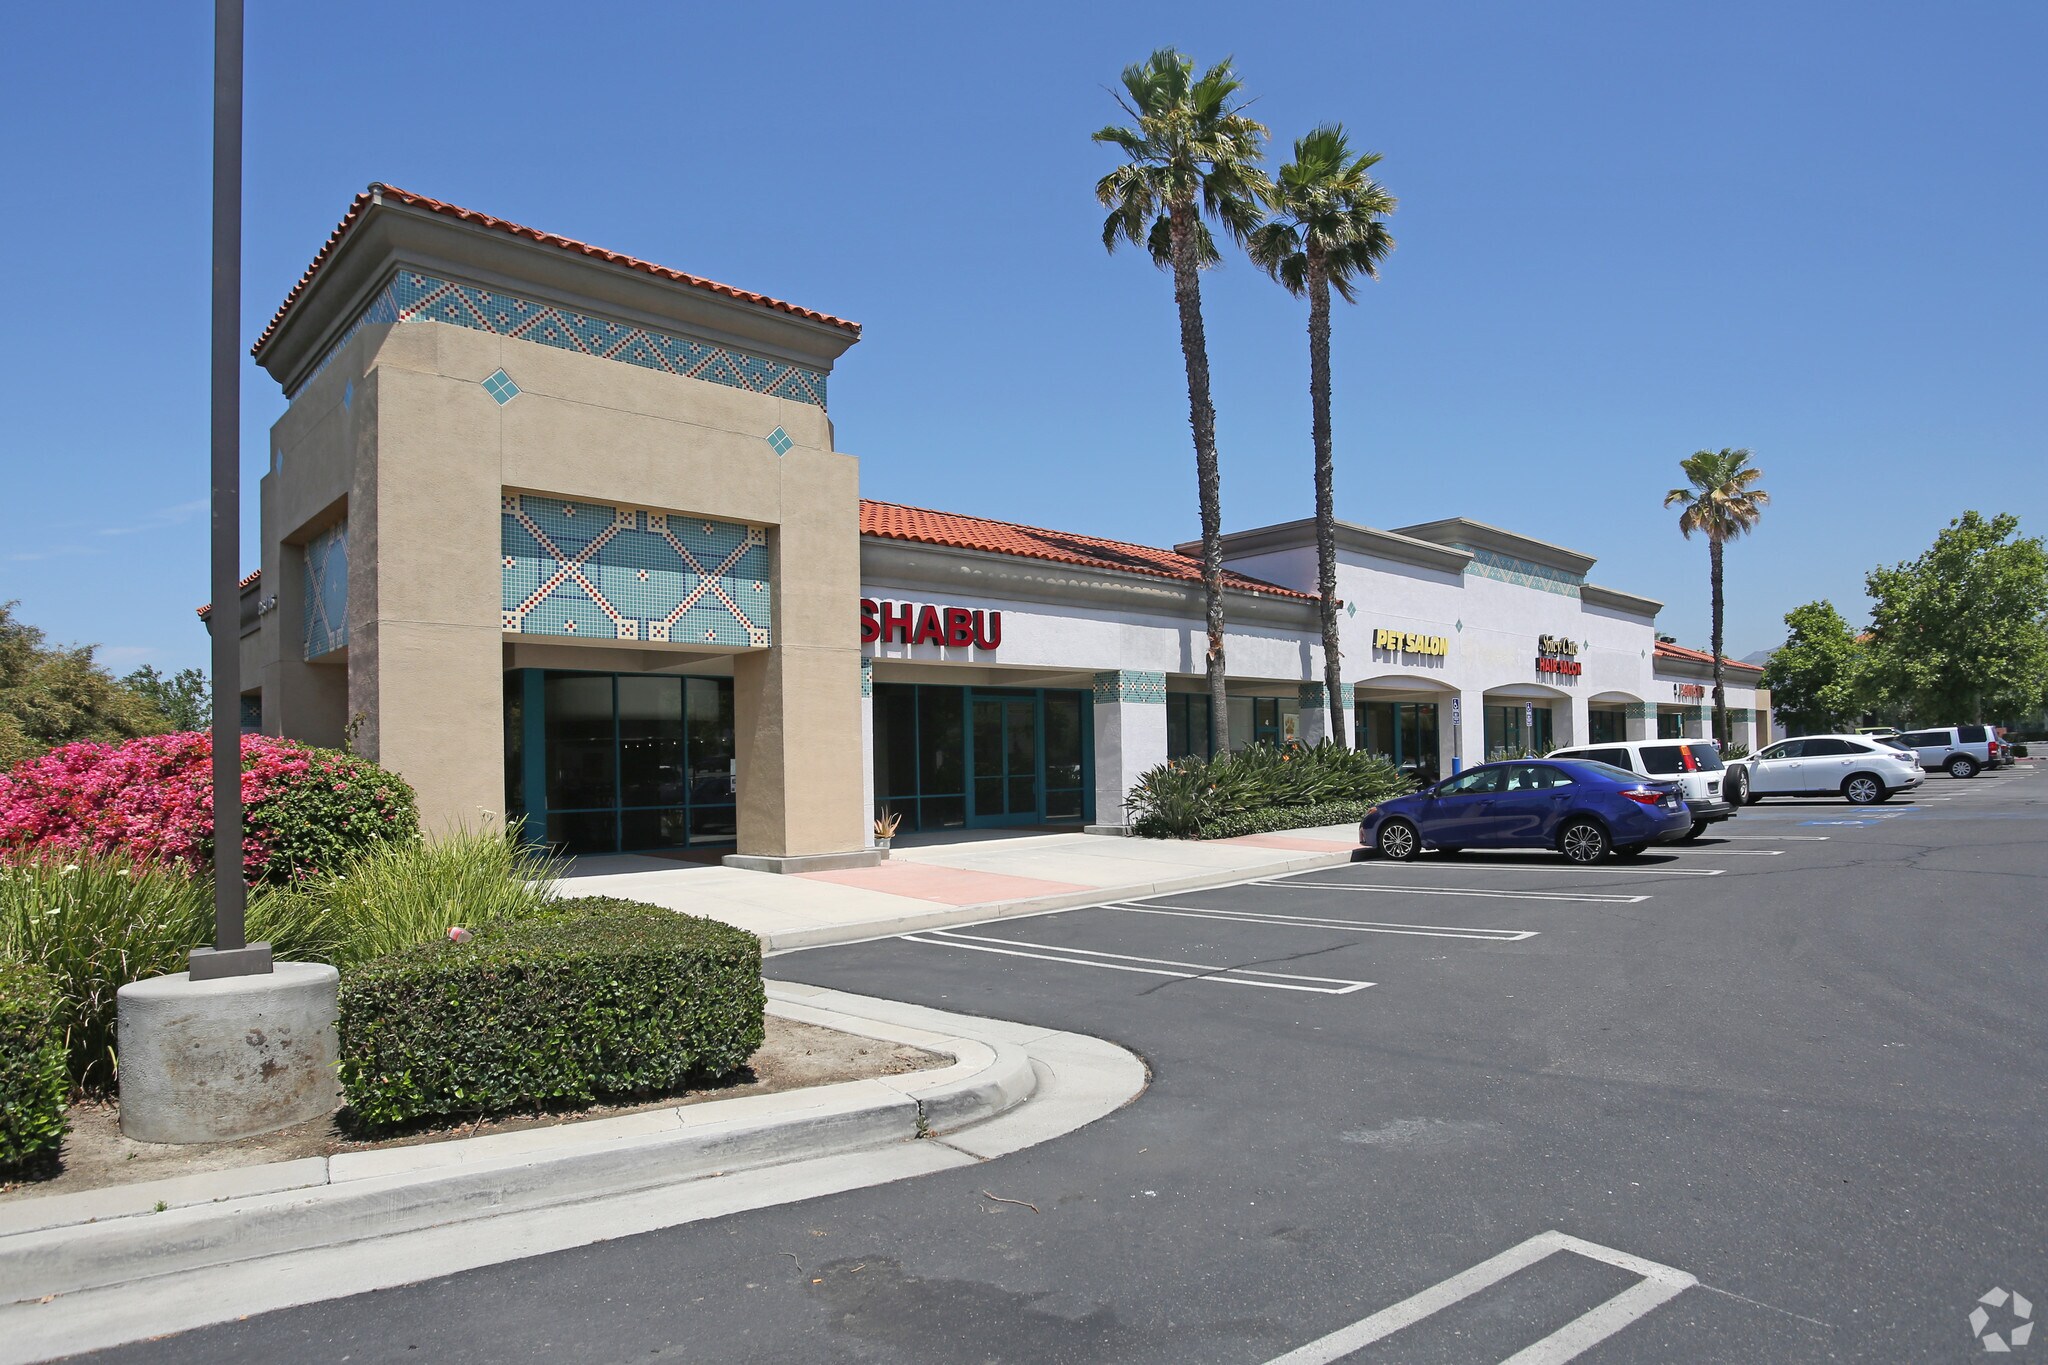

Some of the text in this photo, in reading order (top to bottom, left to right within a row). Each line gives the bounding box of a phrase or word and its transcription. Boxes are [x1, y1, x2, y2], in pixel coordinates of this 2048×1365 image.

[860, 599, 1001, 650] SHABU
[1374, 629, 1449, 655] PET SALON
[1540, 634, 1561, 656] Spicy
[1537, 658, 1582, 675] HAIR SALON
